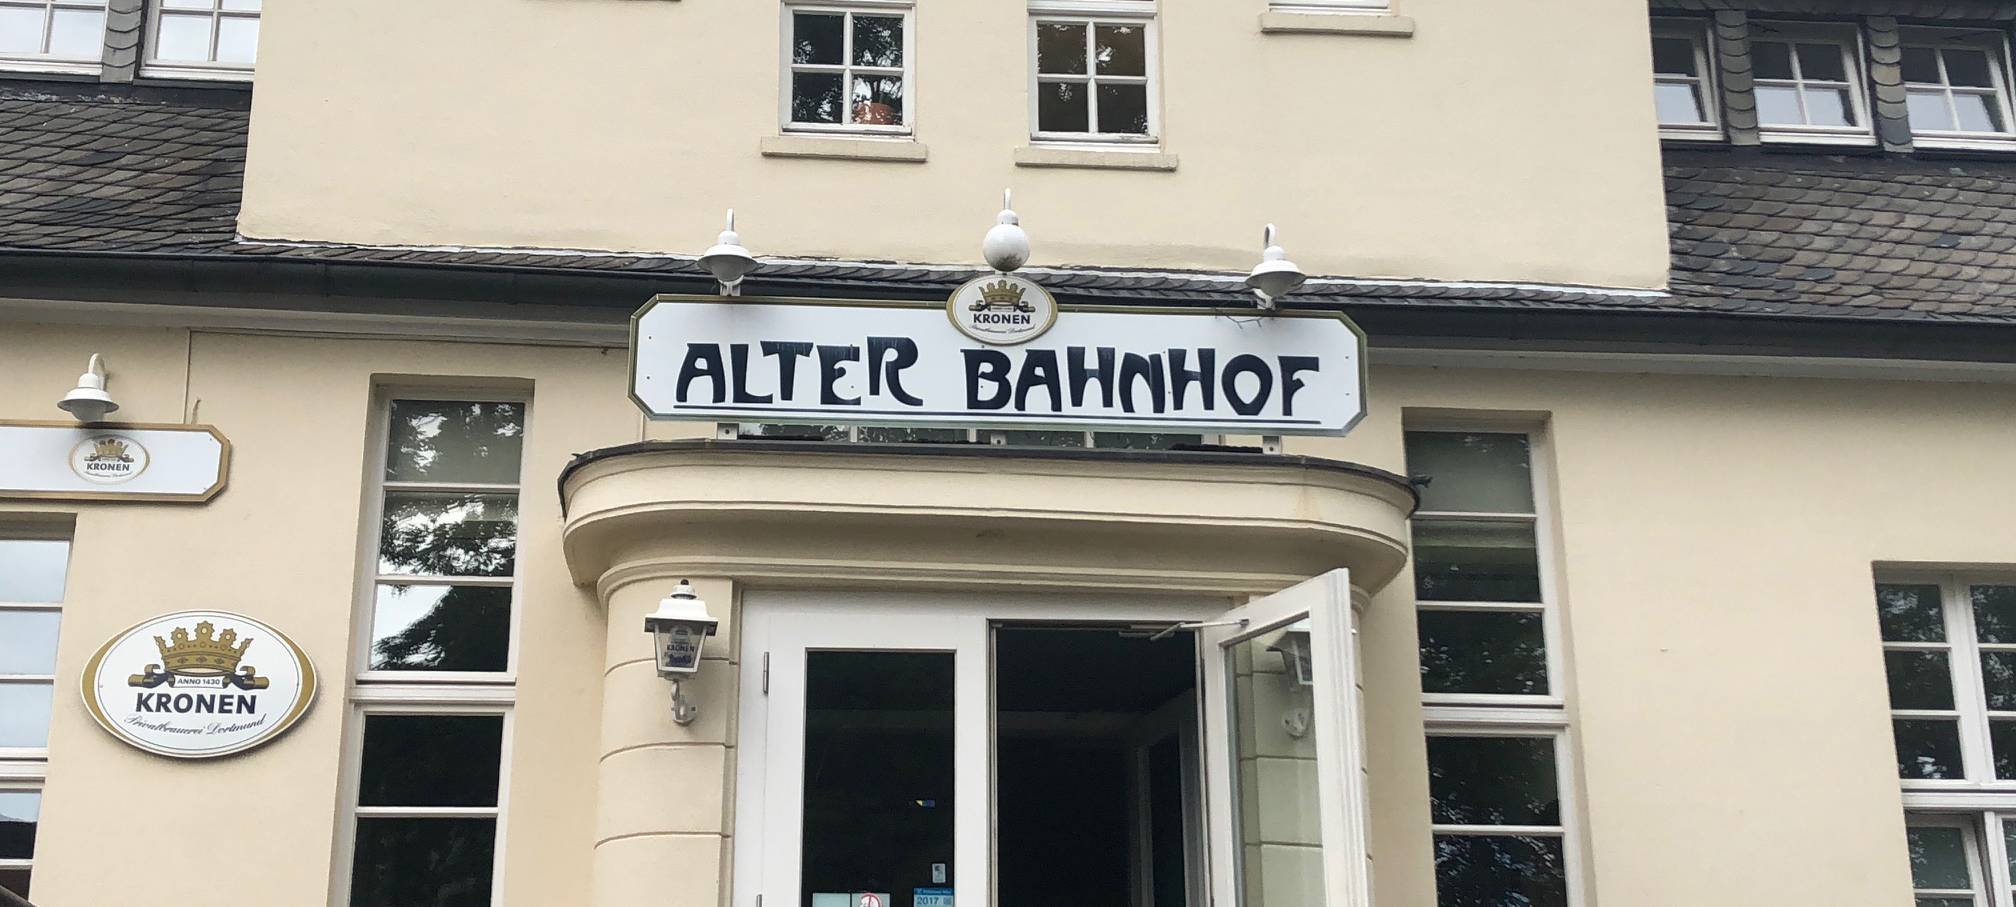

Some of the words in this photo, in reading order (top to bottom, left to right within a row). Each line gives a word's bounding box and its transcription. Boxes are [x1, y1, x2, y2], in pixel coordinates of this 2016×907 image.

[974, 314, 1030, 324] KRONEN
[675, 337, 923, 406] ALTER
[960, 345, 1320, 416] BAHNHOF
[86, 463, 130, 471] KRONEN
[667, 644, 695, 652] KRONEN
[136, 693, 257, 714] KRONEN
[123, 714, 204, 734] Privatbrauerei
[205, 713, 266, 734] Dortmund
[917, 896, 939, 905] 2017
